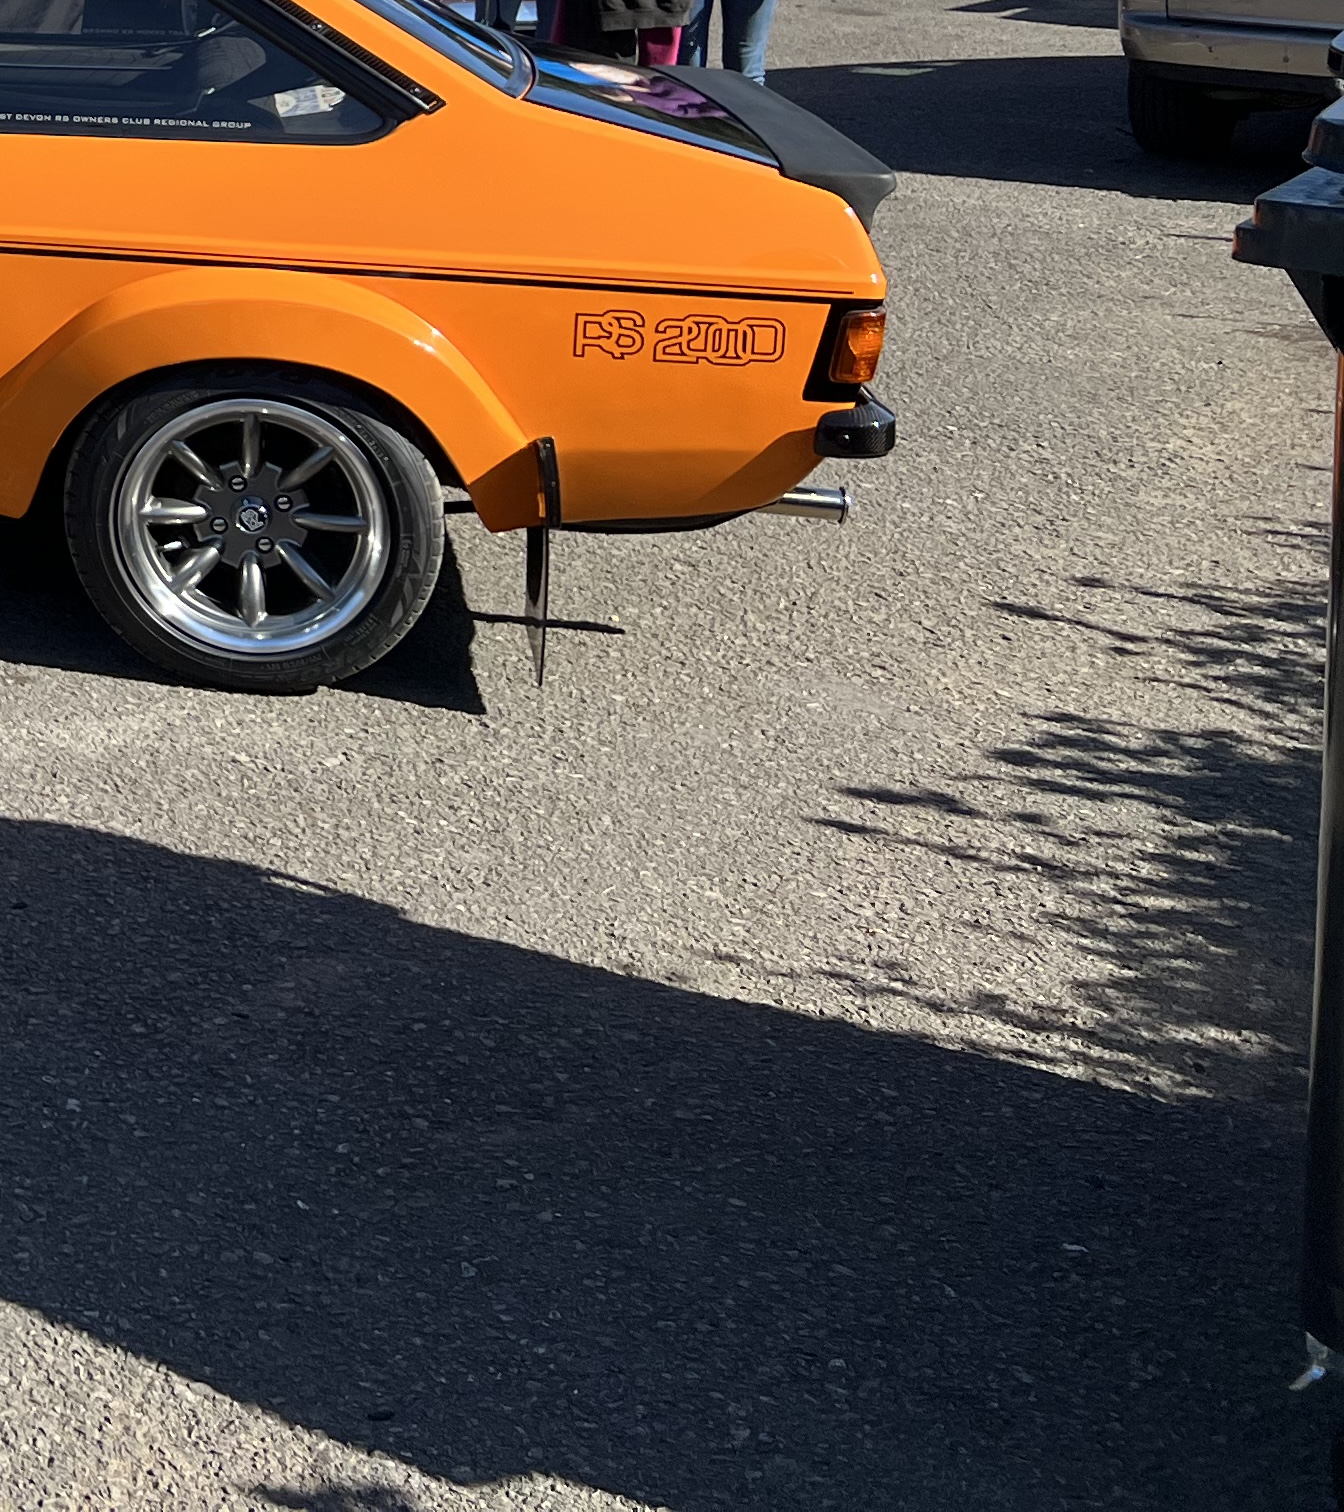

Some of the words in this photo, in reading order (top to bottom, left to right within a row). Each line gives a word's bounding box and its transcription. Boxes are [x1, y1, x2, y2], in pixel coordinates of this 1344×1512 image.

[15, 113, 52, 121] DEVON
[72, 116, 119, 124] OWNERS
[122, 117, 151, 125] CLUB
[153, 118, 210, 127] REGIONAL
[212, 121, 252, 129] GROUP
[573, 309, 646, 360] RS
